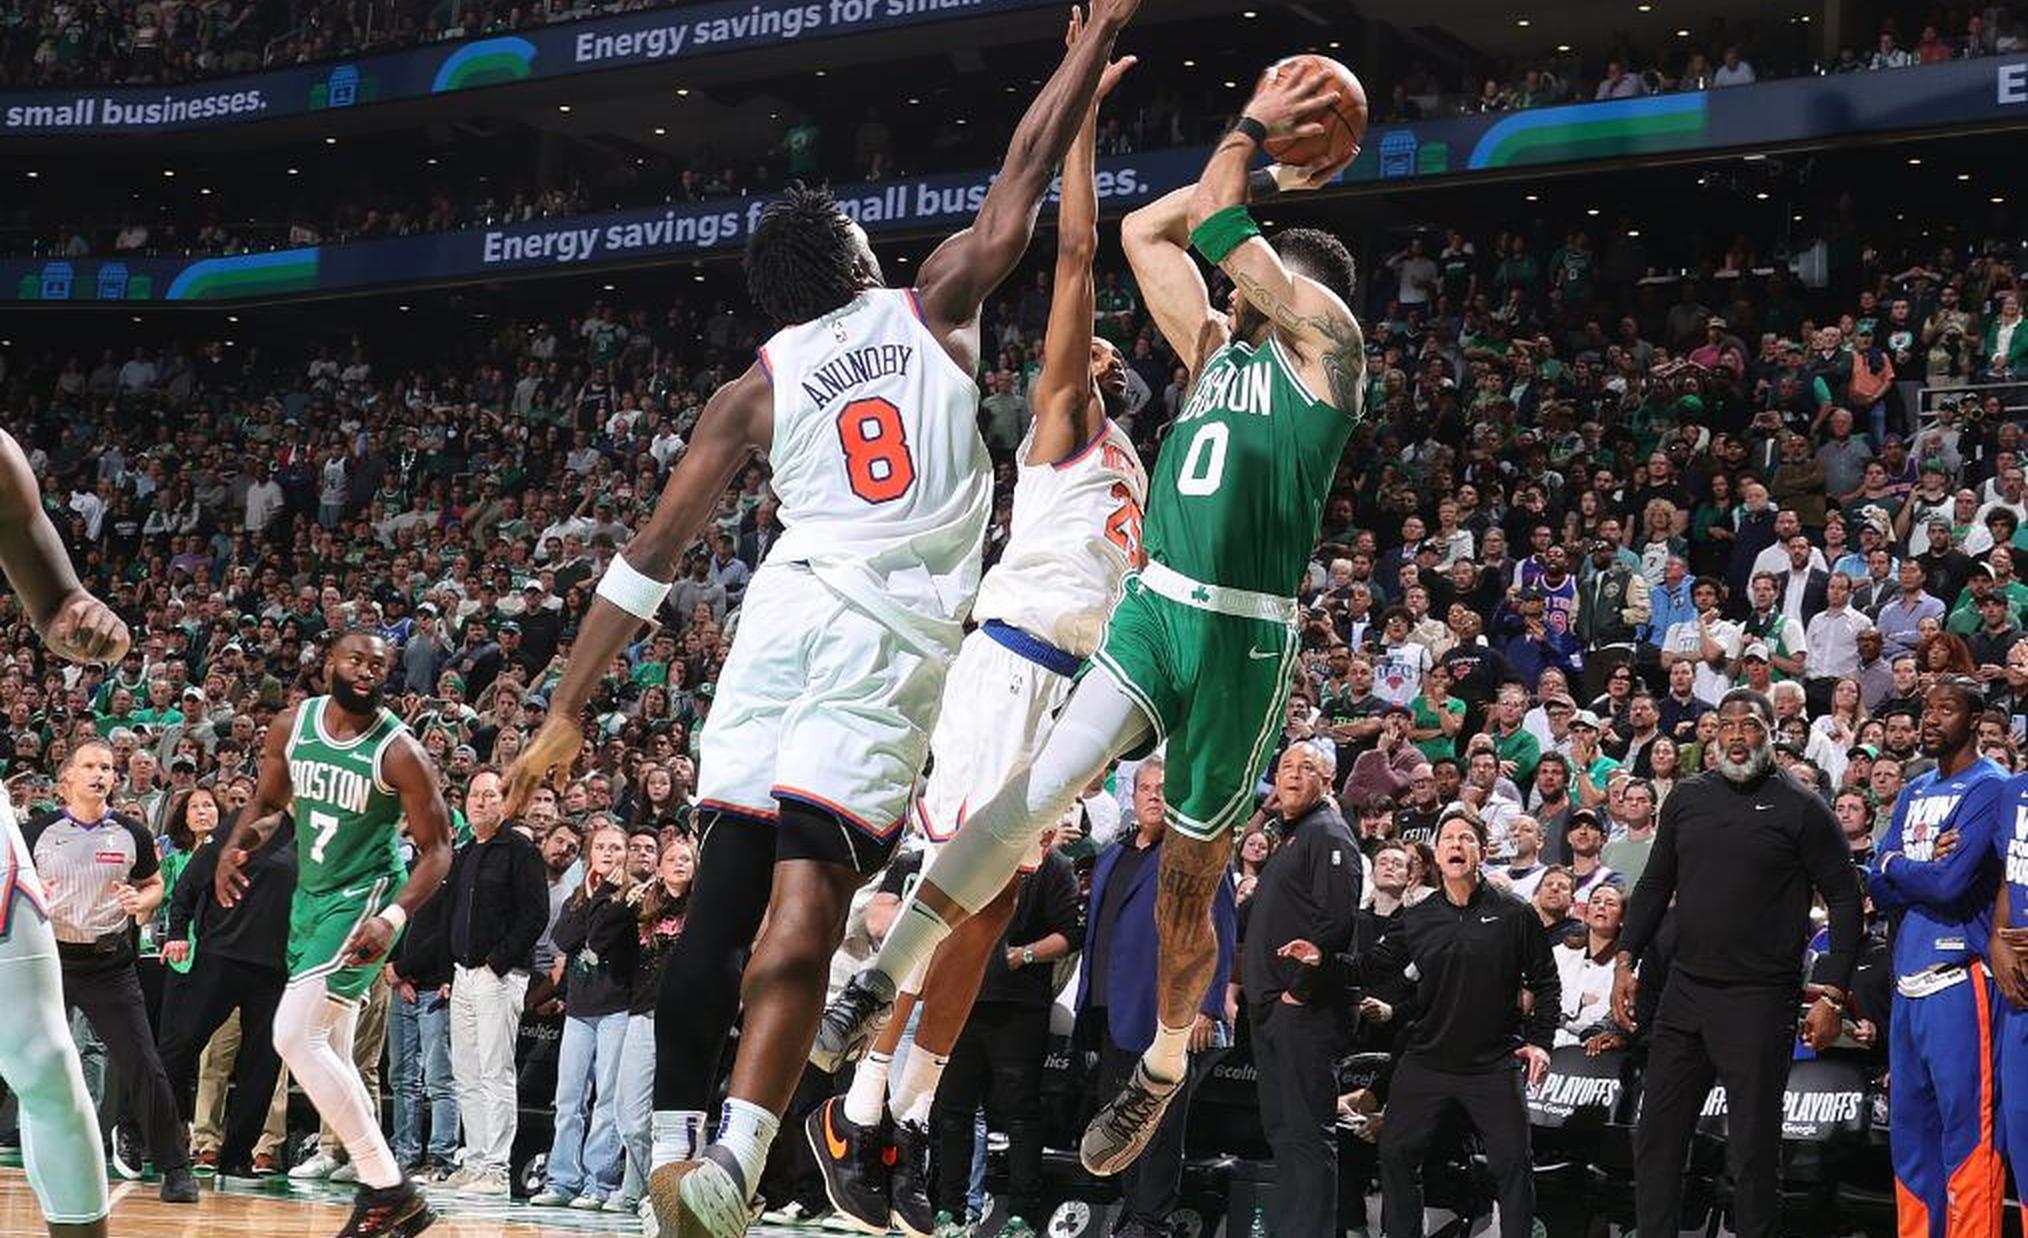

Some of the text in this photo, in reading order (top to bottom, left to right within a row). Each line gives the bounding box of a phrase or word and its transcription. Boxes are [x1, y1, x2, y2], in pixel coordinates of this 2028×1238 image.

[575, 24, 688, 62] Energy
[693, 4, 822, 44] savings
[829, 0, 879, 25] for
[6, 90, 268, 127] small businesses.
[1998, 63, 2027, 104] E
[483, 228, 600, 262] Energy
[605, 211, 739, 250] savings
[801, 344, 913, 411] ANUNOBY
[836, 396, 916, 505] 8
[1177, 421, 1229, 496] 0
[290, 760, 372, 814] BOSTON
[310, 810, 339, 865] 7
[1539, 1073, 1621, 1107] PLAYOFFS
